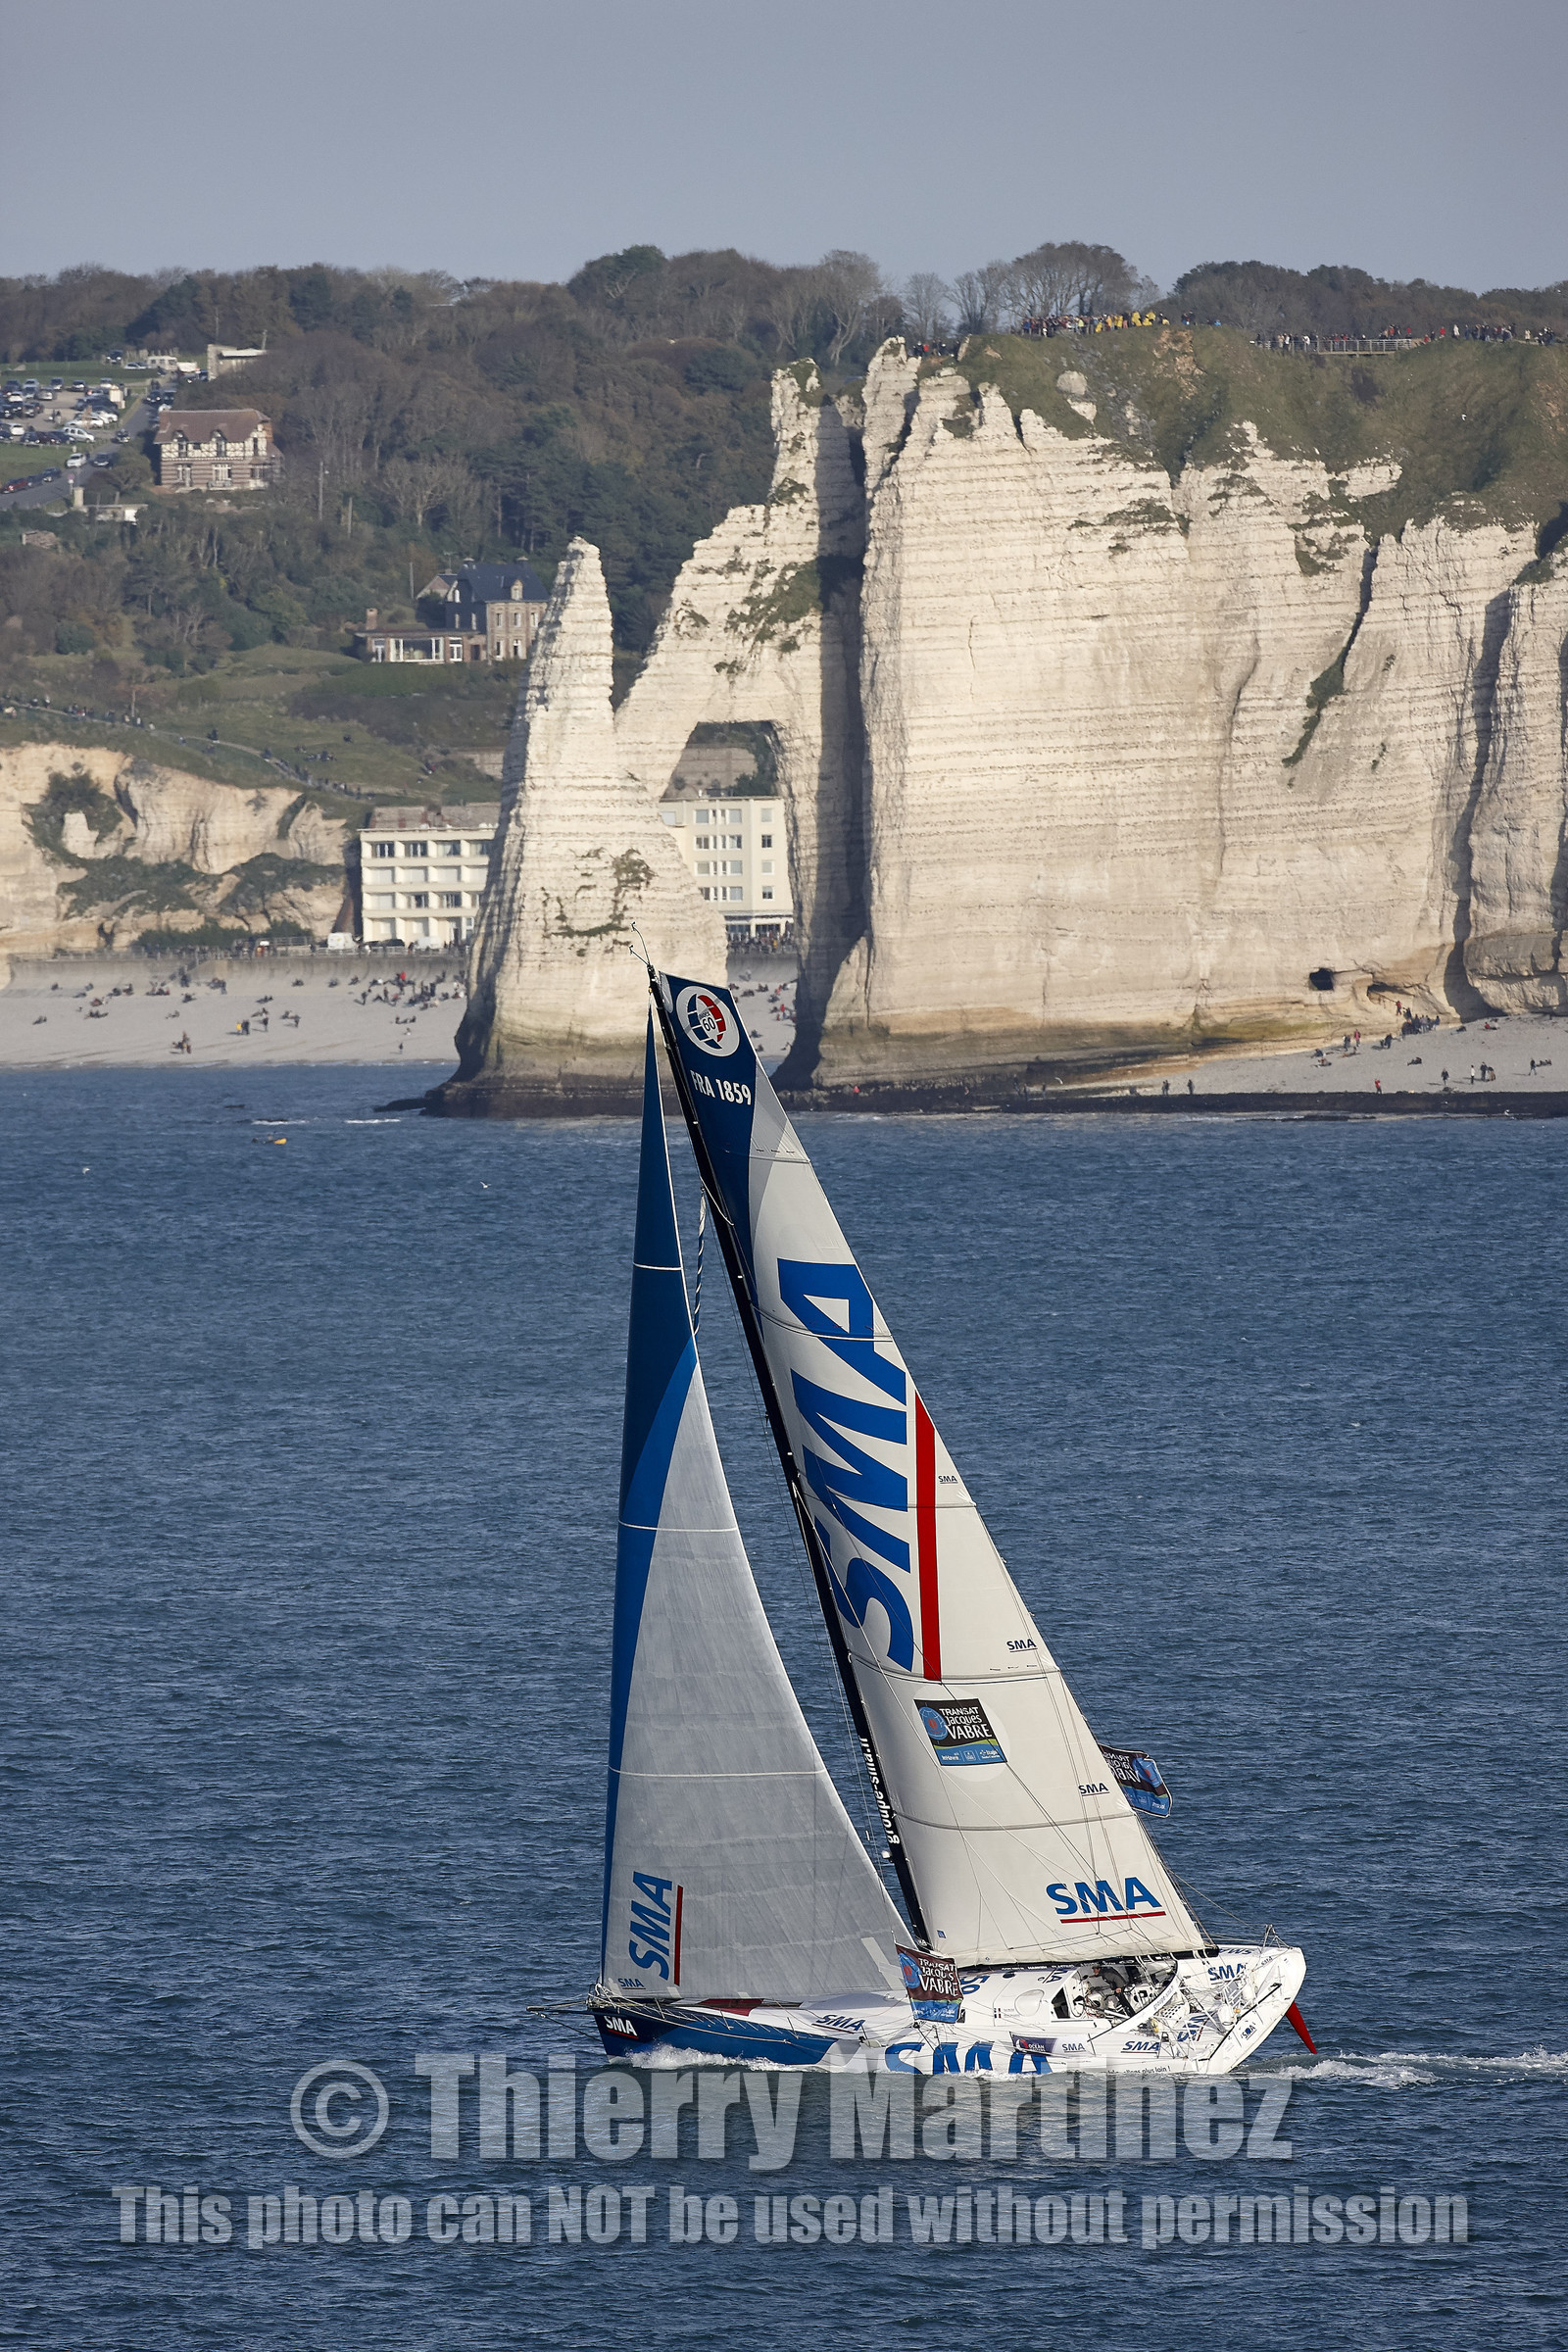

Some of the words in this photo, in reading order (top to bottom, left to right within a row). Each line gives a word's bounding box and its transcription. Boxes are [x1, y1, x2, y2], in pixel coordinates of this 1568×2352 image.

[703, 1017, 716, 1031] 60
[690, 1069, 715, 1099] FRA
[715, 1078, 752, 1105] 1859
[777, 1258, 914, 1673] SMA
[938, 1474, 958, 1484] SMA
[1006, 1639, 1037, 1650] SMA
[939, 1706, 979, 1716] TRANSAT
[945, 1724, 993, 1740] VABRE
[1078, 1783, 1109, 1794] SMA
[1046, 1877, 1163, 1915] SMA
[629, 1871, 673, 1981] SMA
[618, 1978, 644, 1988] SMA
[918, 1974, 959, 1997] VABRE
[605, 2015, 637, 2036] SMA
[815, 2014, 866, 2032] SMA
[1061, 2042, 1086, 2051] SMA
[1122, 2040, 1161, 2051] SMA
